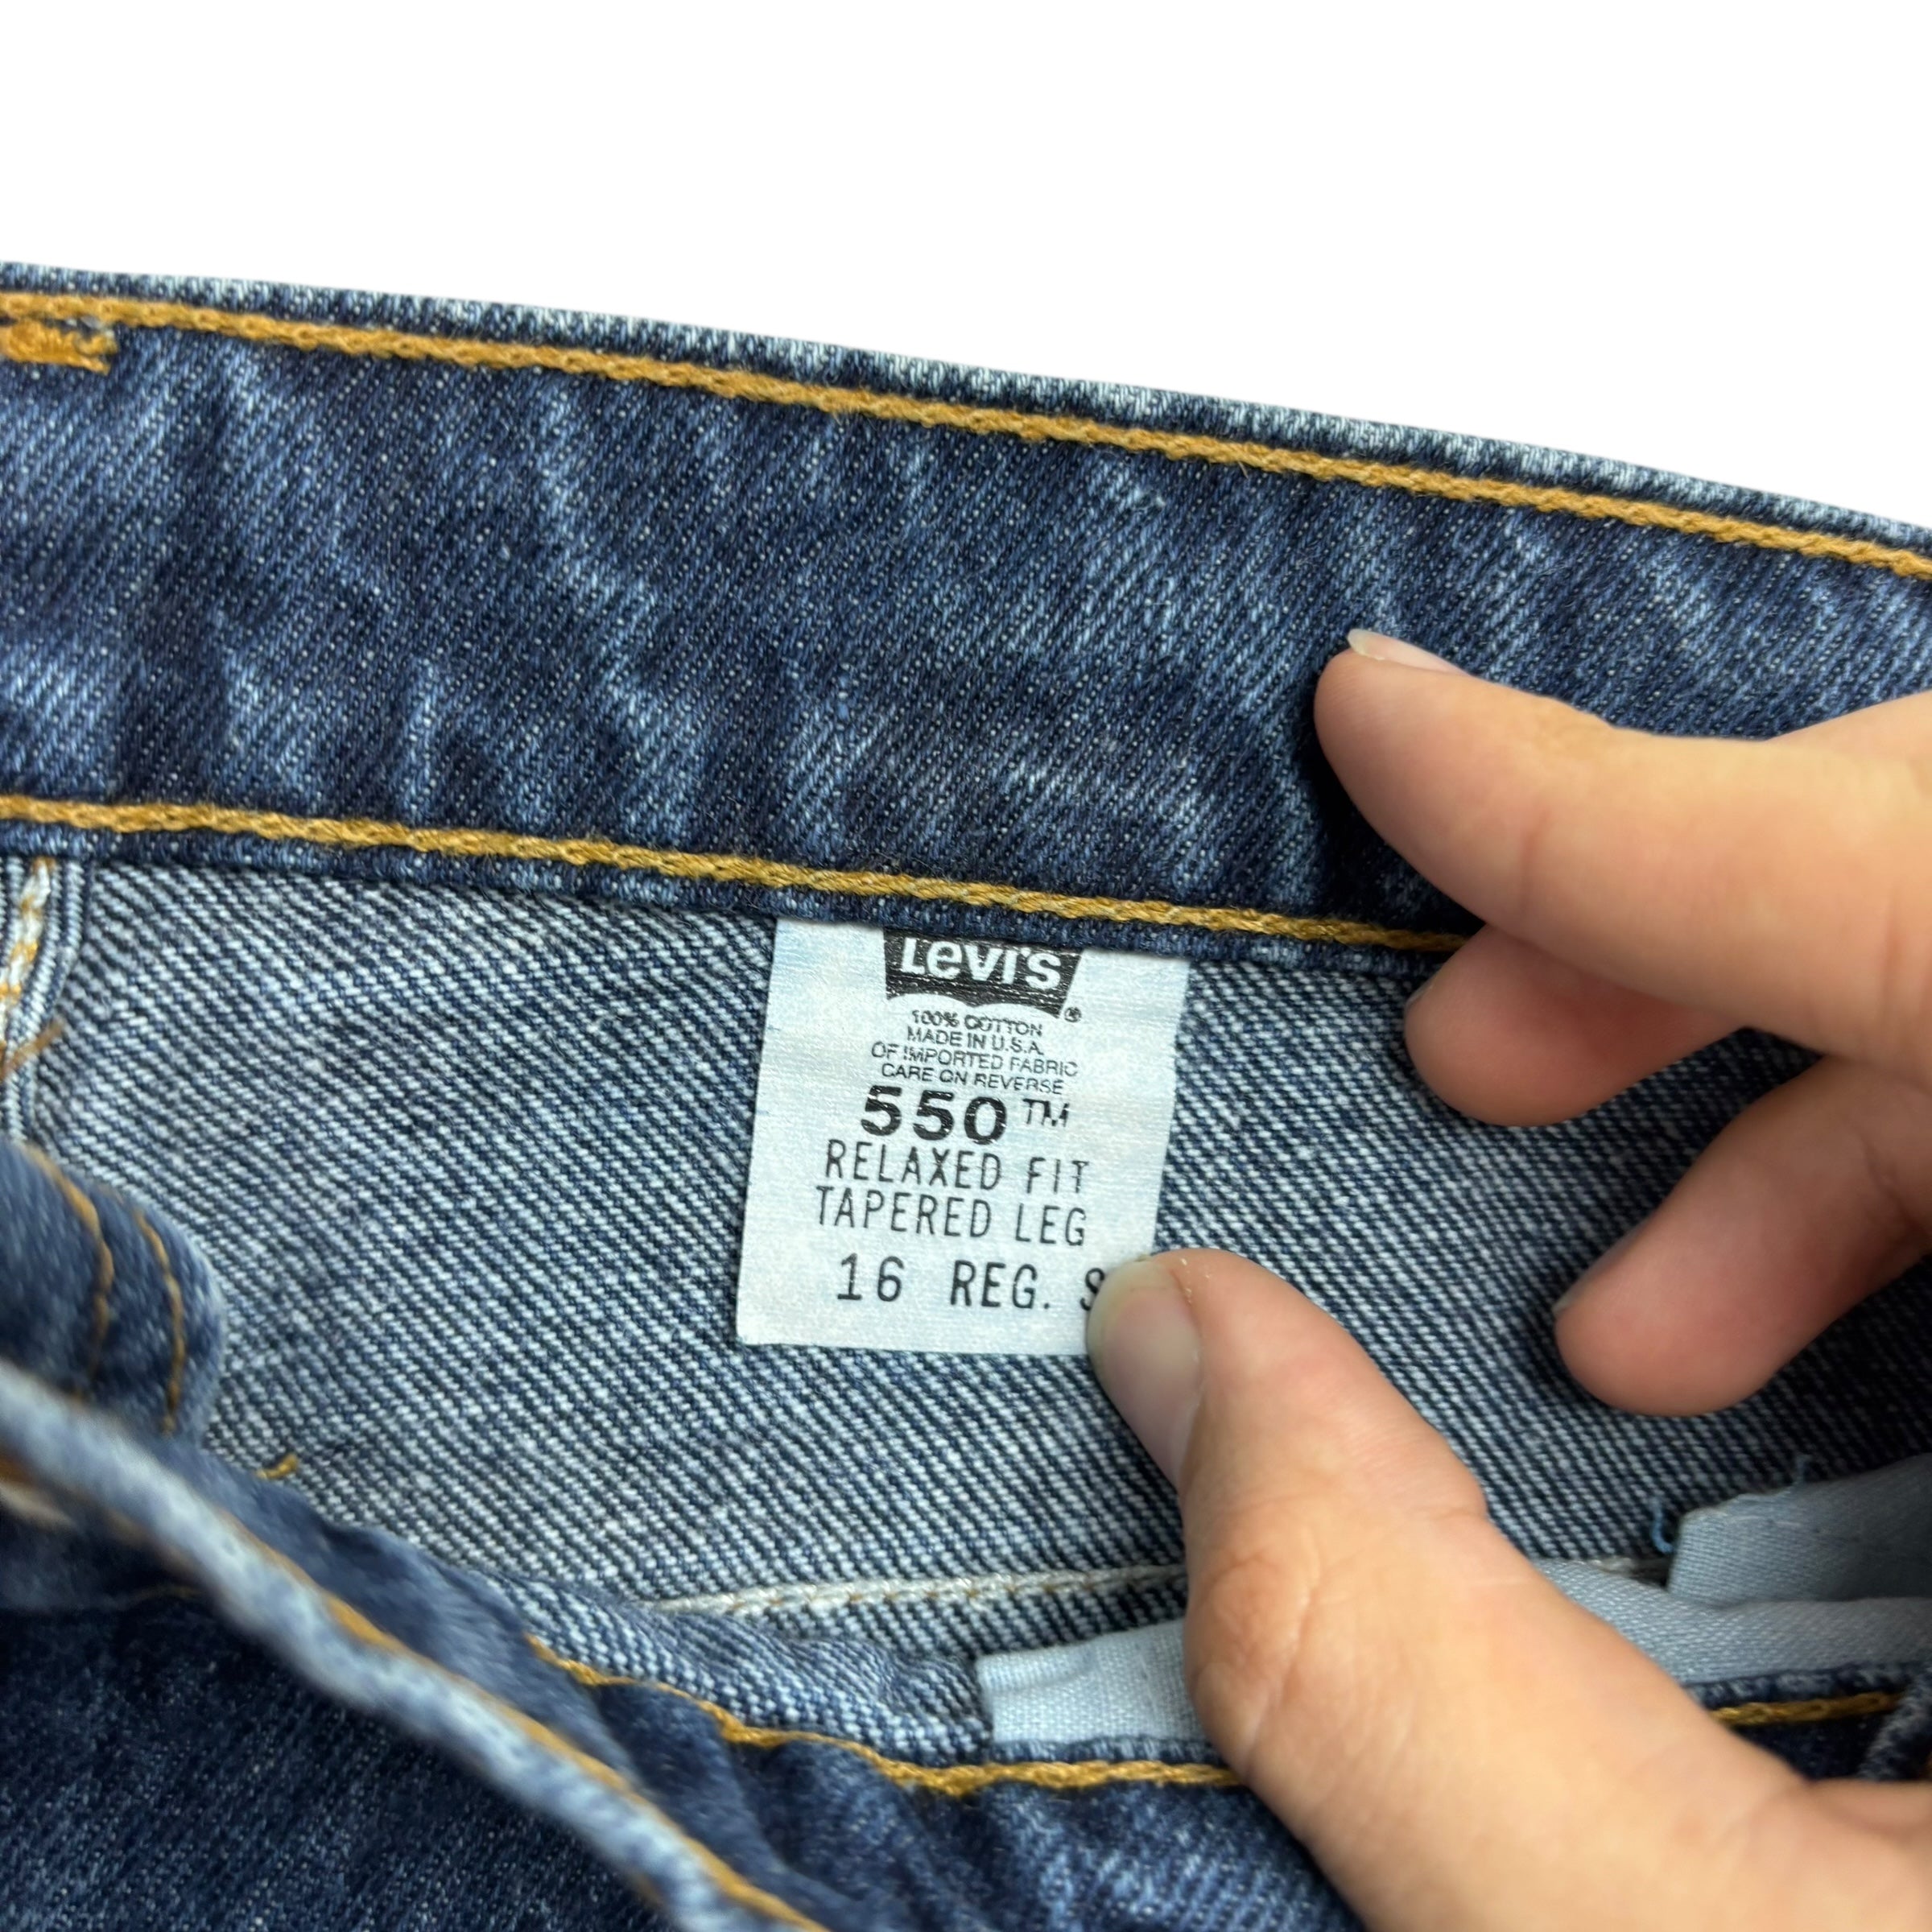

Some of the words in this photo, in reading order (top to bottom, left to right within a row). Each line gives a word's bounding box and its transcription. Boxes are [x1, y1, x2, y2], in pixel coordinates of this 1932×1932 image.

[900, 936, 1062, 990] Levi's
[906, 1026, 963, 1047] MADE
[967, 1033, 987, 1049] IN
[911, 1009, 960, 1027] 100%
[964, 1014, 1042, 1037] COTTON
[871, 1041, 899, 1060] OF
[902, 1046, 1004, 1071] IMPORTED
[1009, 1056, 1079, 1077] FABRIC
[881, 1063, 935, 1082] CARE
[939, 1069, 968, 1085] ON
[973, 1072, 1065, 1095] REVERSE
[825, 1138, 1002, 1191] RELAXED
[1026, 1156, 1090, 1194] FIT
[815, 1185, 993, 1238] TAPERED
[1014, 1203, 1087, 1247] LEG
[836, 1252, 906, 1302] 16
[950, 1259, 1051, 1310] REG.
